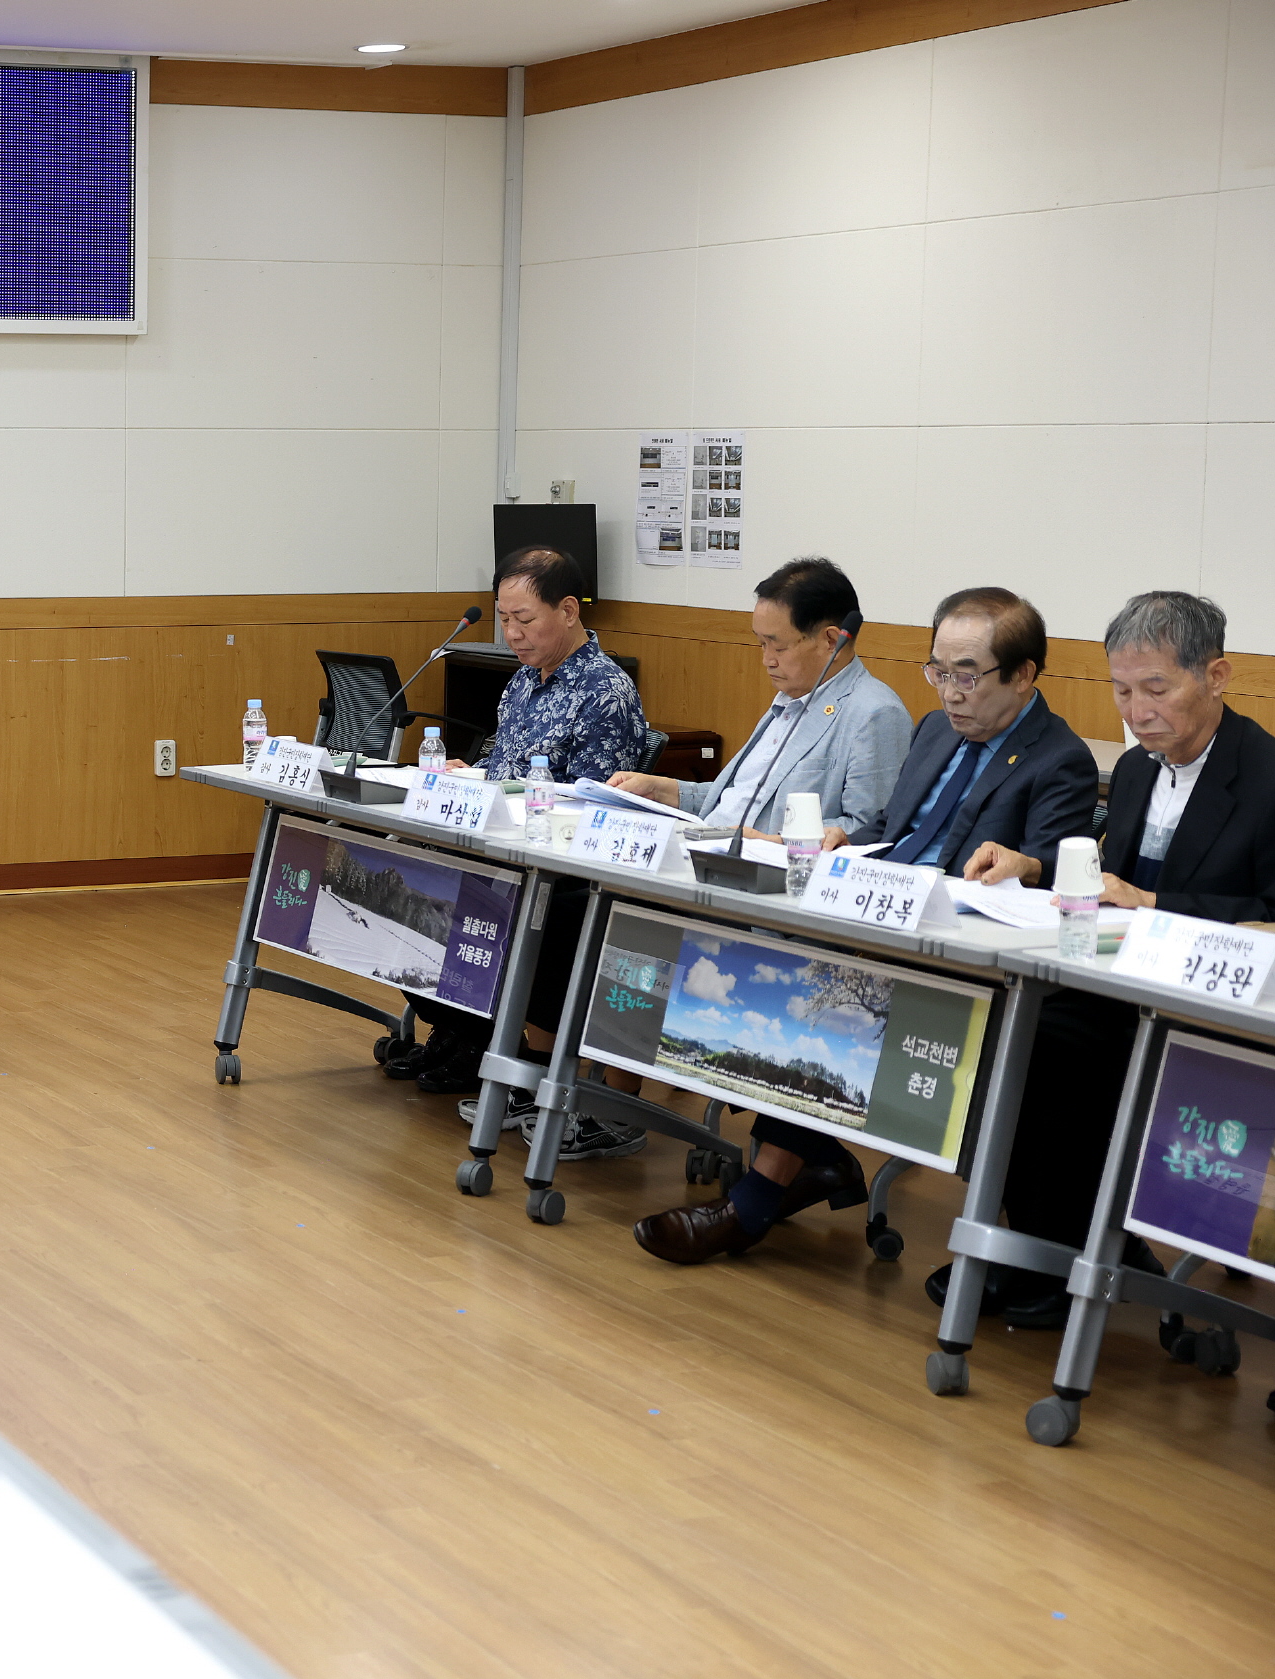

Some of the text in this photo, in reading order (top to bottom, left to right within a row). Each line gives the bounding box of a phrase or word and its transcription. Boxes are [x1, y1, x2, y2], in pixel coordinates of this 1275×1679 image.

[279, 763, 311, 789] 김홍식
[584, 837, 599, 852] 이사
[281, 862, 298, 889] 강진
[851, 866, 915, 891] 강진군민장학재단
[821, 887, 915, 926] 이사 이창복
[462, 915, 498, 940] 월출다원
[456, 943, 493, 968] 겨울풍경
[1137, 950, 1254, 999] 이사 김상완
[901, 1034, 959, 1069] 석교천변
[907, 1072, 938, 1099] 춘경
[1178, 1105, 1216, 1151] 강진
